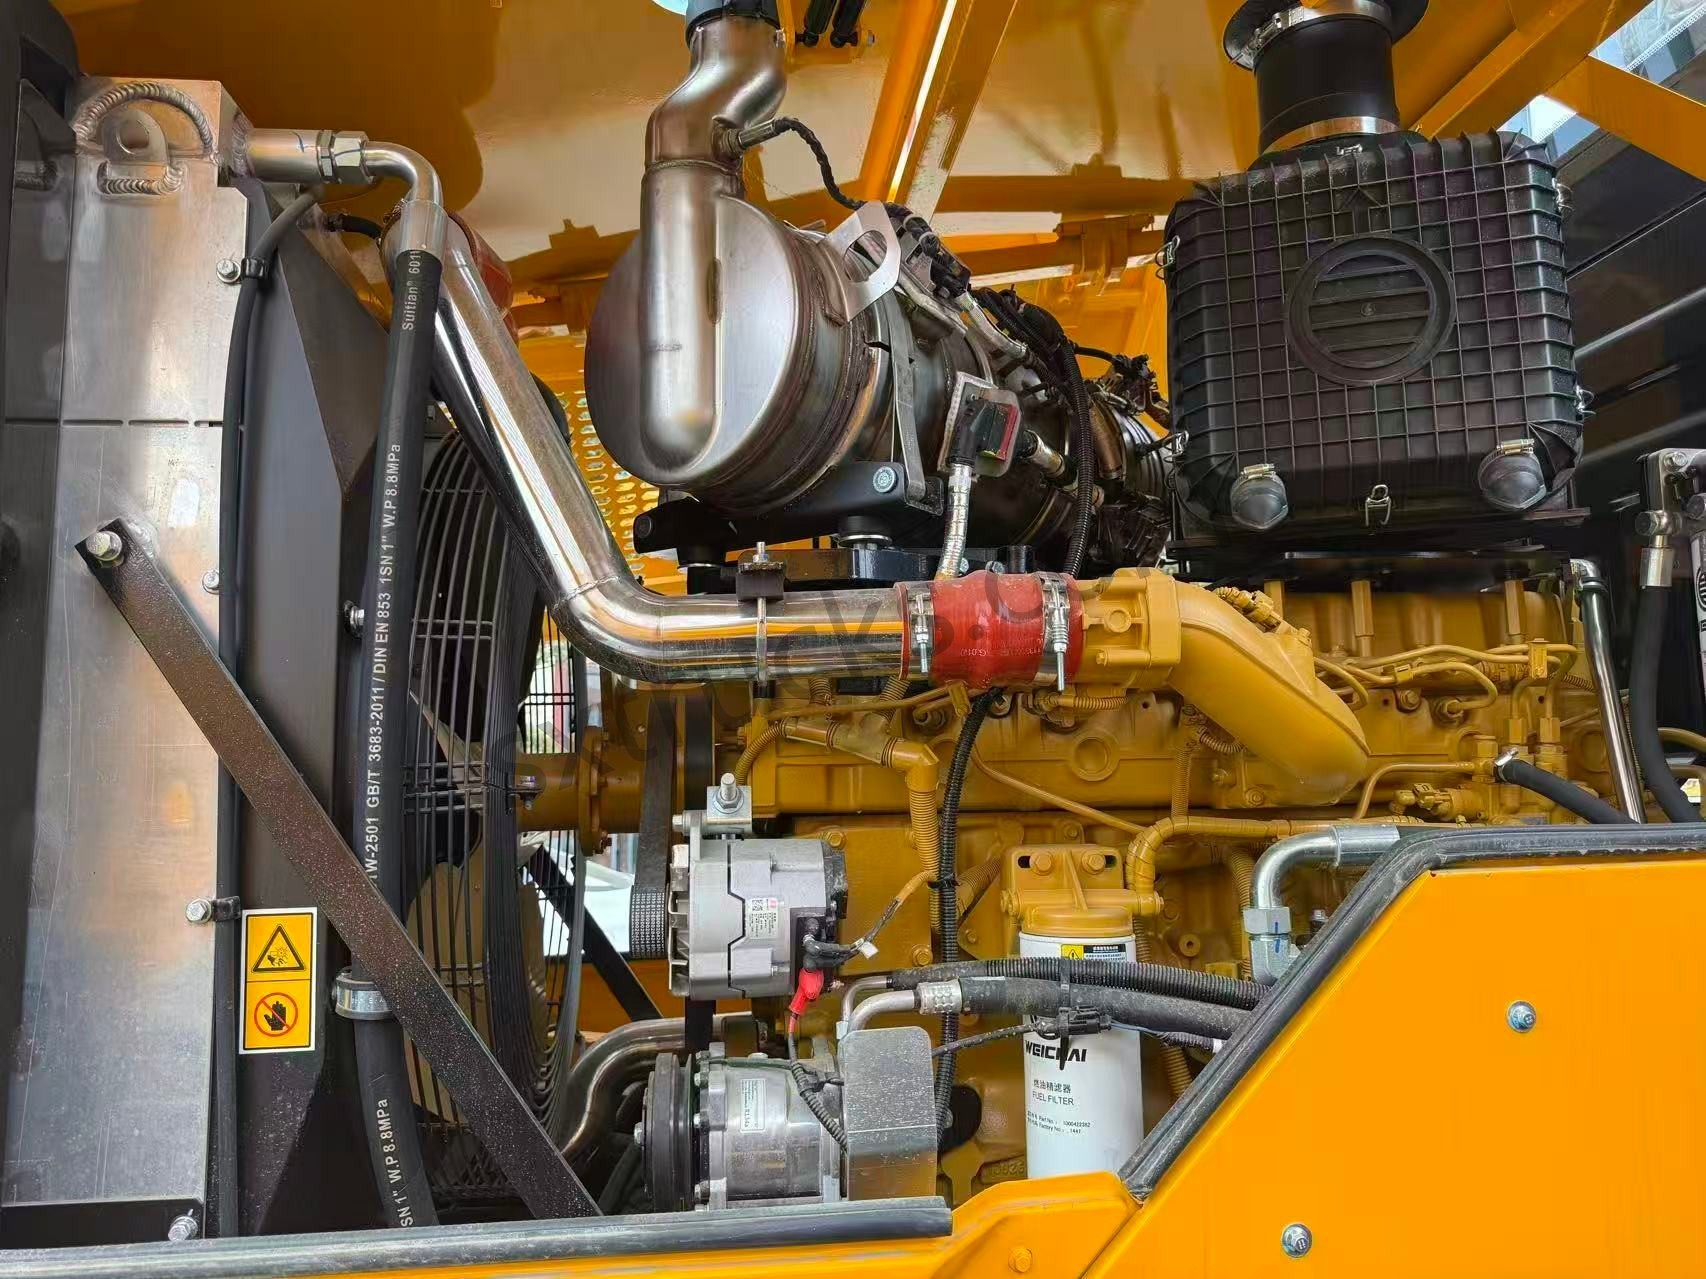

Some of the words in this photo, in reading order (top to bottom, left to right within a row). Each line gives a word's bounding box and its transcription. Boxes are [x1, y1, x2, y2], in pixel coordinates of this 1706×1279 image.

[385, 444, 400, 496] 8.8MPa
[379, 555, 394, 584] 1SN
[377, 592, 391, 618] 853
[375, 622, 389, 643] EN
[373, 650, 387, 674] DIN
[368, 687, 385, 762] 3683-2011
[367, 769, 381, 809] GB/T
[1047, 1094, 1074, 1106] FILTER
[376, 1099, 396, 1153] 8.8MPa
